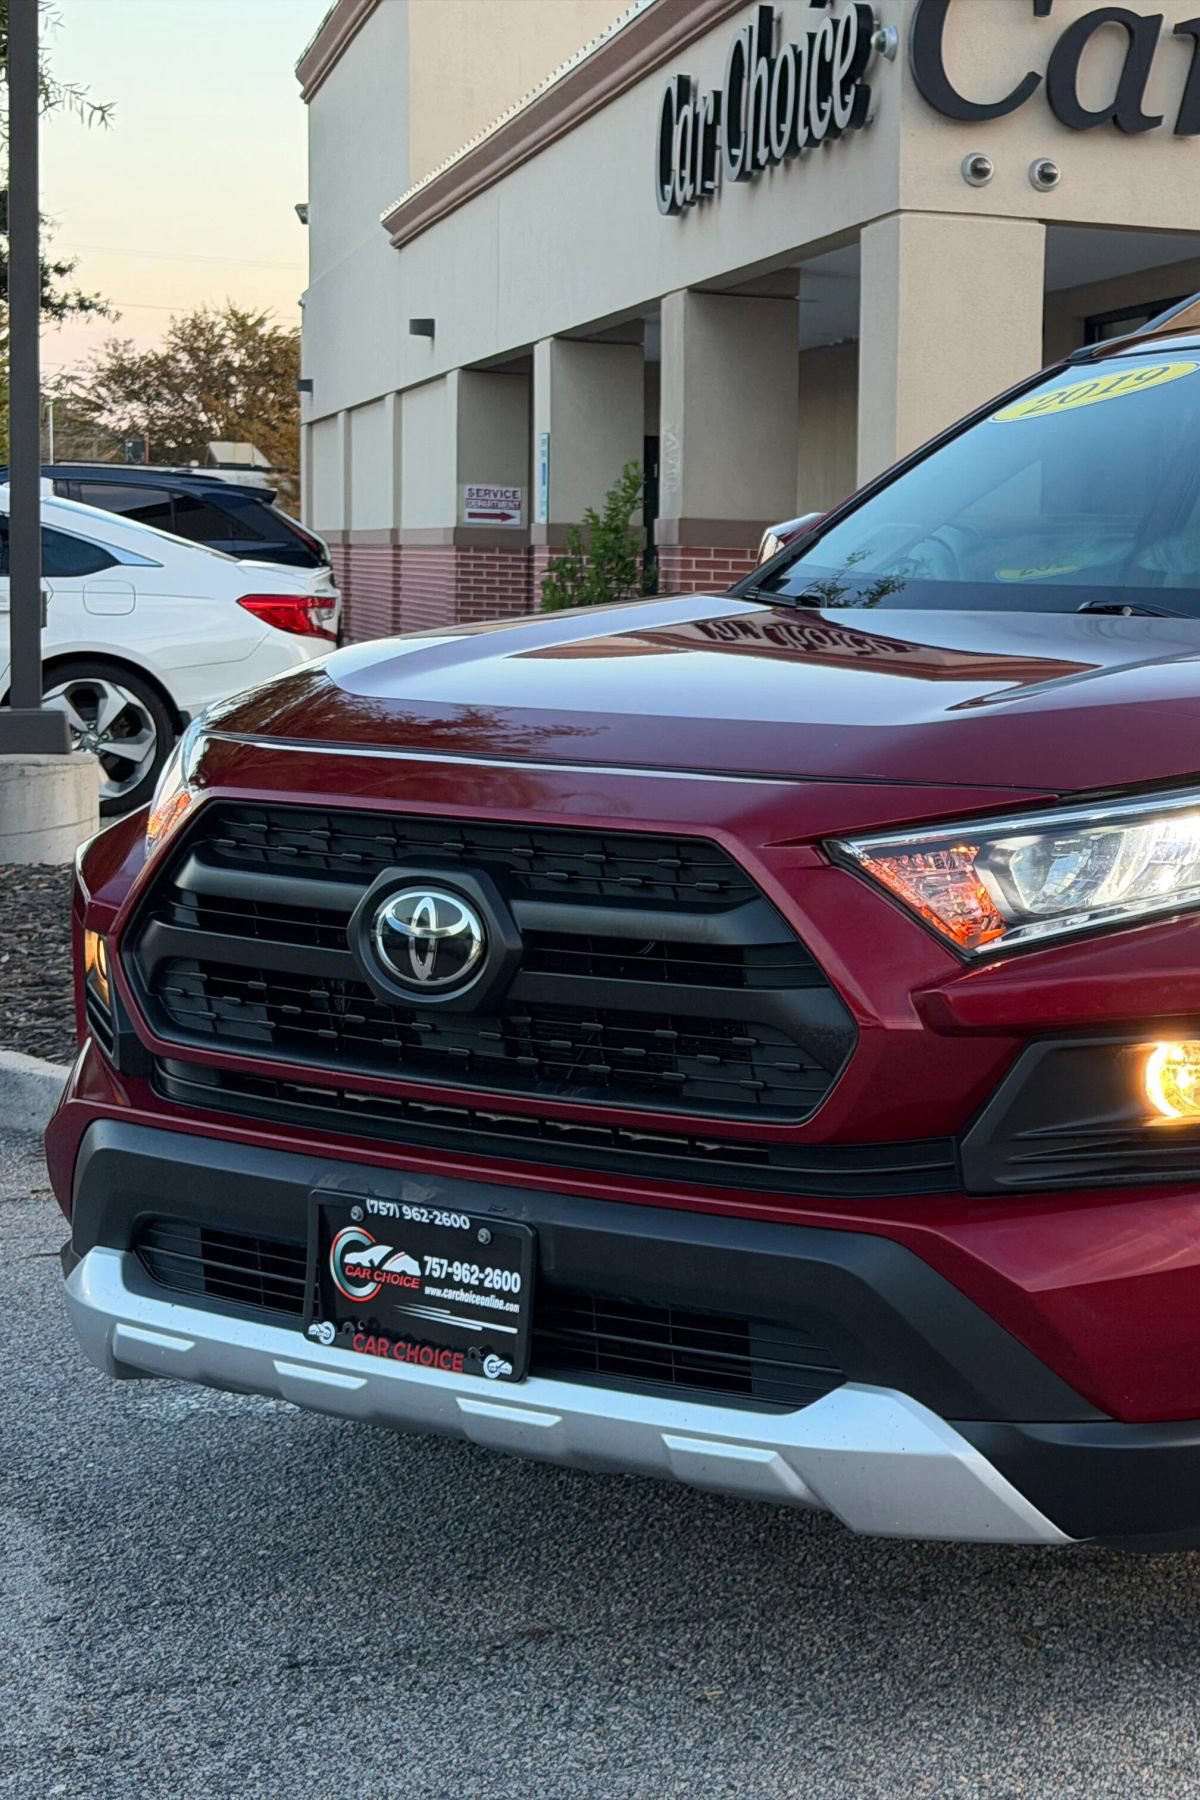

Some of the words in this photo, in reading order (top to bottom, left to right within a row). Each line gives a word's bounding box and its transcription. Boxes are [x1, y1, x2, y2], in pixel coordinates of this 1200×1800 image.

[656, 74, 723, 216] Car
[722, 0, 874, 182] Choice
[1020, 366, 1170, 416] 2019
[467, 487, 520, 500] SERVICE
[365, 1199, 400, 1219] (757)
[403, 1207, 471, 1230] 962-2600
[344, 1265, 371, 1280] CAR
[374, 1269, 421, 1290] CHOICE
[423, 1256, 522, 1294] 757-962-2600
[424, 1285, 520, 1313] www.carchoiceonline.com
[352, 1333, 389, 1357] CAR
[393, 1342, 465, 1373] CHOICE
